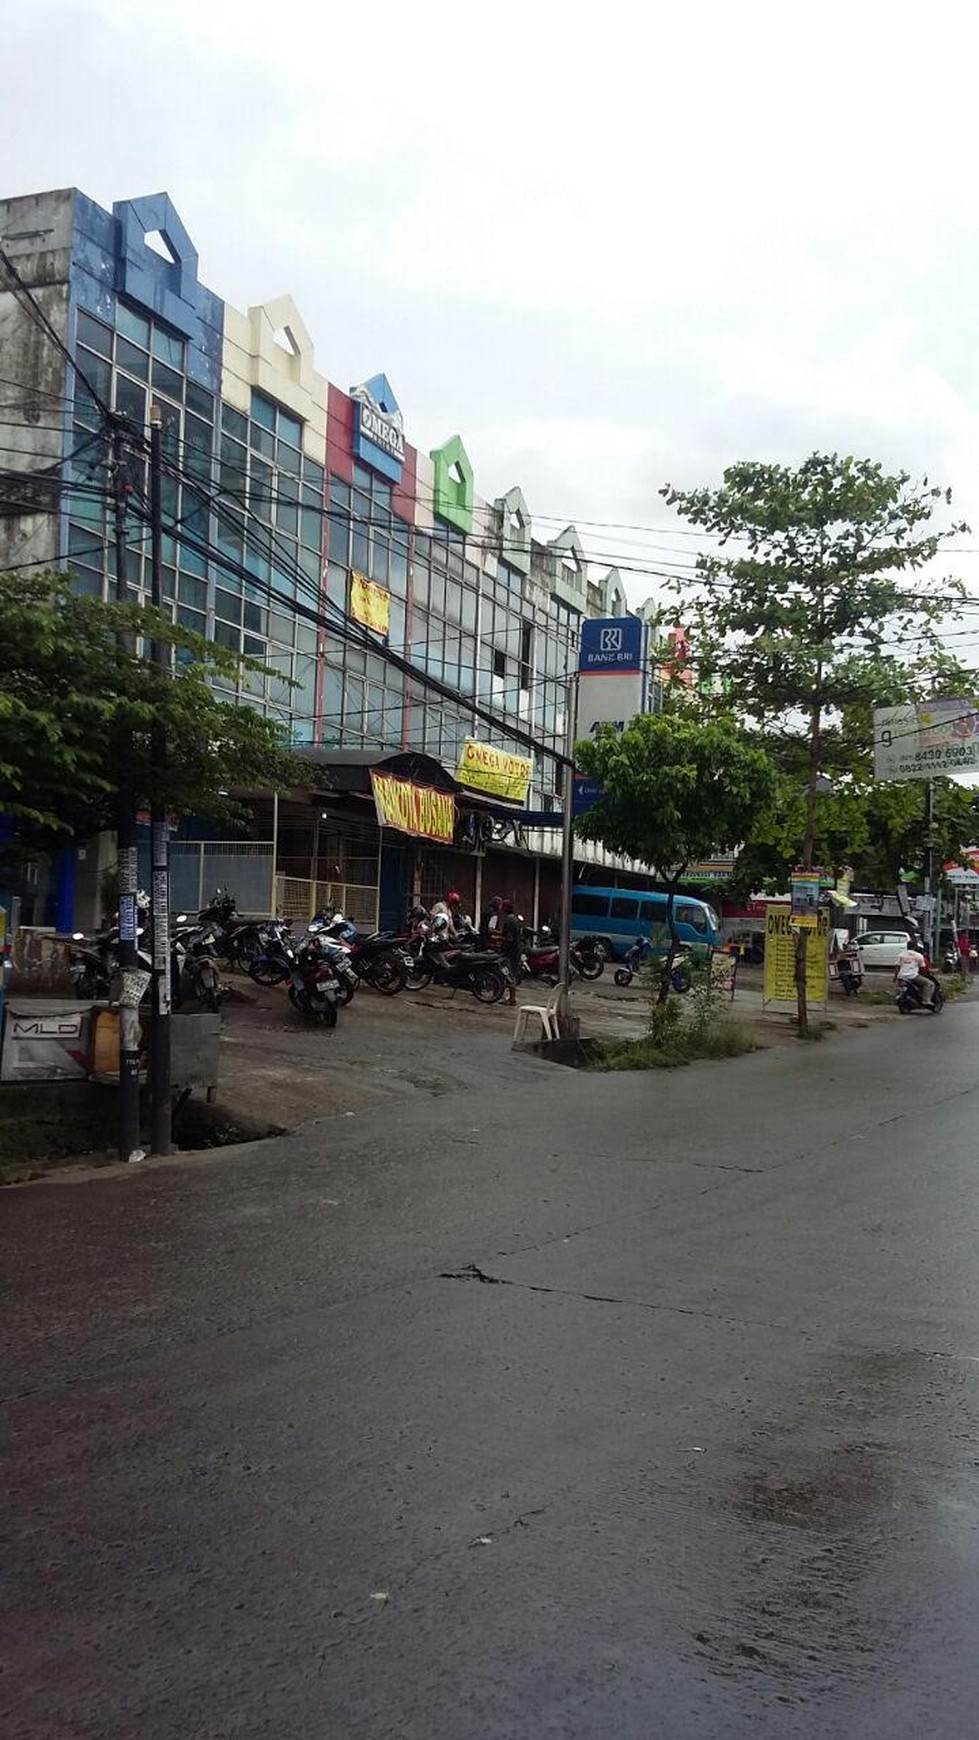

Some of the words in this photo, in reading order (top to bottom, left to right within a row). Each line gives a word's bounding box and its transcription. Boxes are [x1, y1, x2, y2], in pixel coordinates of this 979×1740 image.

[362, 407, 405, 453] OMEGA
[587, 653, 616, 662] BANK
[617, 653, 633, 661] BRI
[13, 1023, 79, 1034] MLD
